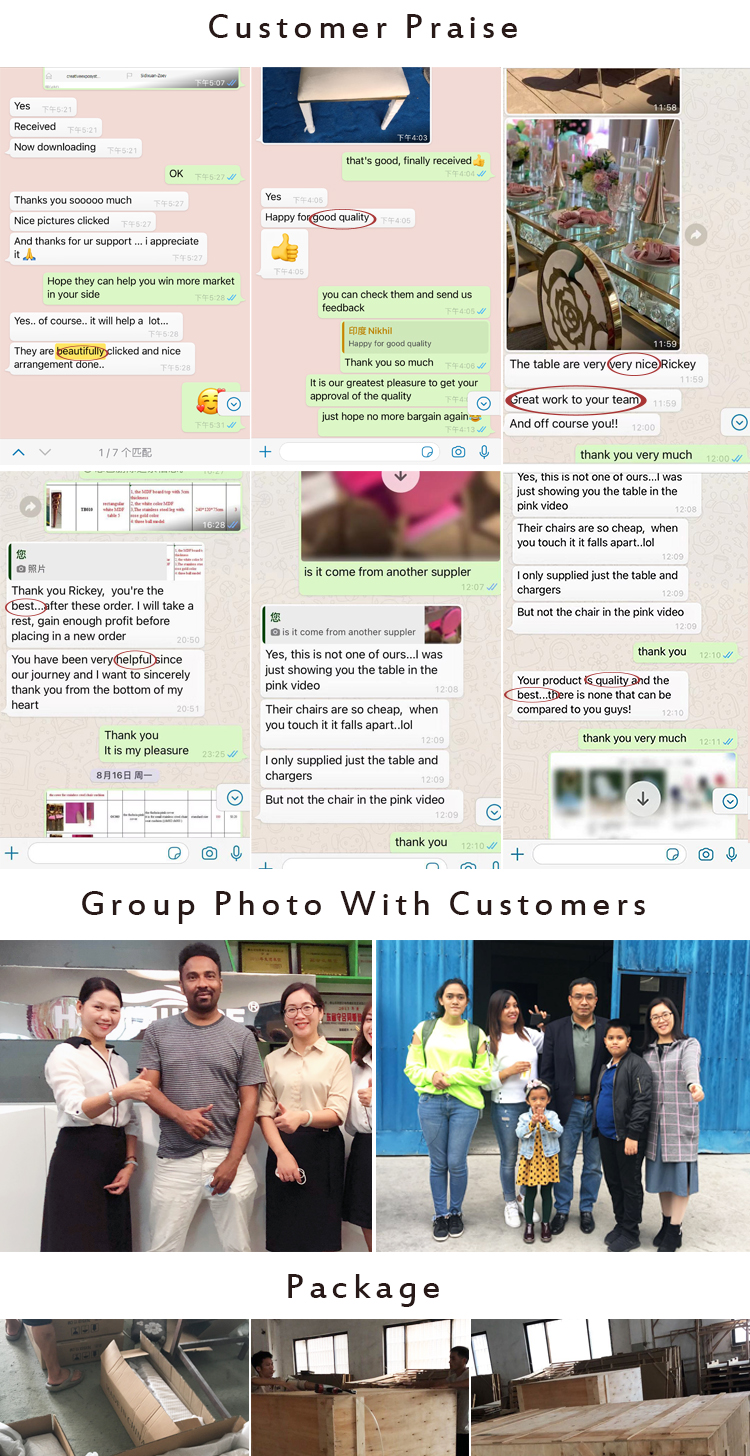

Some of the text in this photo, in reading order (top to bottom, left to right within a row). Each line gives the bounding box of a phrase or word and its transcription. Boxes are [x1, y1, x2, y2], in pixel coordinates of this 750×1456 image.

[195, 79, 225, 87] 下午5:07
[42, 105, 72, 113] 下午5:21
[653, 103, 678, 112] 11:58
[13, 121, 57, 131] Received
[397, 133, 428, 142] 下午4:03
[13, 142, 97, 154] Now downloading
[13, 195, 133, 207] Thanks you sooooo much
[265, 212, 370, 223] Happy for good quality
[348, 326, 393, 336] 印度 Nikhil
[348, 339, 432, 349] Happy for good quality
[653, 339, 678, 348] 11:59
[13, 346, 37, 357] They
[56, 346, 105, 357] beautifully
[106, 346, 140, 356] clicked
[141, 346, 159, 356] and
[161, 346, 181, 356] nice
[13, 359, 105, 371] arrangement done..
[509, 359, 697, 372] The table are very very nice Rickey
[510, 394, 640, 408] Great work to your team
[98, 447, 153, 459] 1 / 7 个匹配
[675, 505, 698, 514] 12:08
[202, 521, 226, 529] 16:28
[15, 549, 27, 560] 您
[27, 564, 46, 574] 照片
[11, 585, 165, 598] Thank you Rickey, you're the
[282, 627, 417, 638] is it come from another suppler
[265, 703, 439, 717] Their chairs are so cheap, when
[516, 704, 632, 717] compared to you guys!
[104, 744, 190, 758] It is my pleasure
[96, 770, 153, 781] 8月16日 周一
[265, 770, 313, 783] chargers
